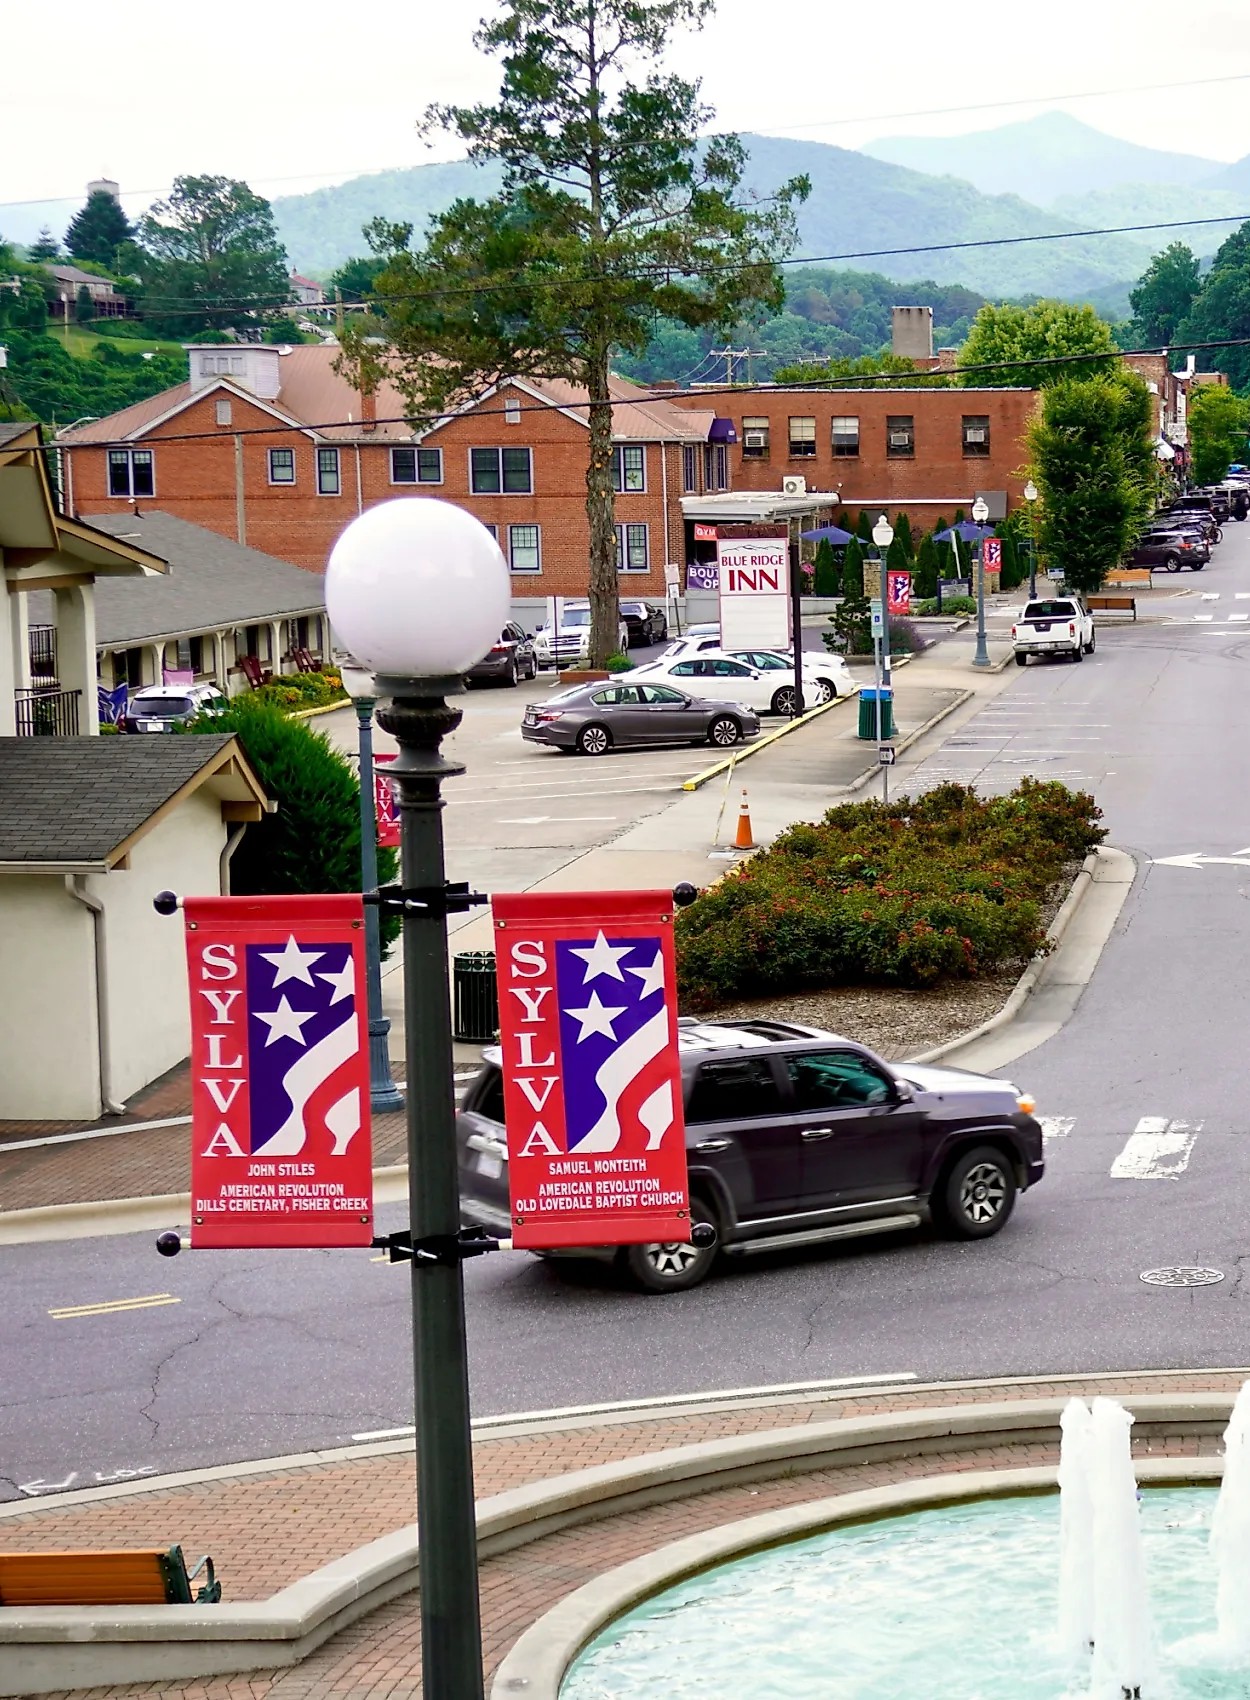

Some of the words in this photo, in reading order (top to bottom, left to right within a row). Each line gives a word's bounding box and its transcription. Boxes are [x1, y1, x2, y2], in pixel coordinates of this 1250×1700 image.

[696, 528, 716, 537] GYM
[721, 556, 747, 566] BLUE
[750, 555, 785, 566] RIDGE
[728, 569, 779, 591] INN
[377, 762, 392, 823] YLVA
[199, 944, 248, 1157] SYLVA
[508, 940, 565, 1157] SYLVA
[247, 1164, 276, 1177] JOHN
[278, 1163, 315, 1176] STILES
[549, 1162, 592, 1176] SAMUEL
[594, 1159, 647, 1174] MONTEITH
[220, 1184, 275, 1197] AMERICAN
[278, 1183, 344, 1197] REVOLUTION
[538, 1181, 593, 1197] AMERICAN
[596, 1178, 660, 1194] REVOLUTION
[196, 1199, 227, 1212] DILLS
[228, 1199, 290, 1214] CEMETARY,
[292, 1198, 331, 1211] FISHER
[333, 1197, 369, 1210] CREEK
[516, 1199, 537, 1212] OLD
[539, 1197, 593, 1212] LOVEDALE
[596, 1194, 637, 1208] BAPTIST
[640, 1191, 684, 1206] CHURCH
